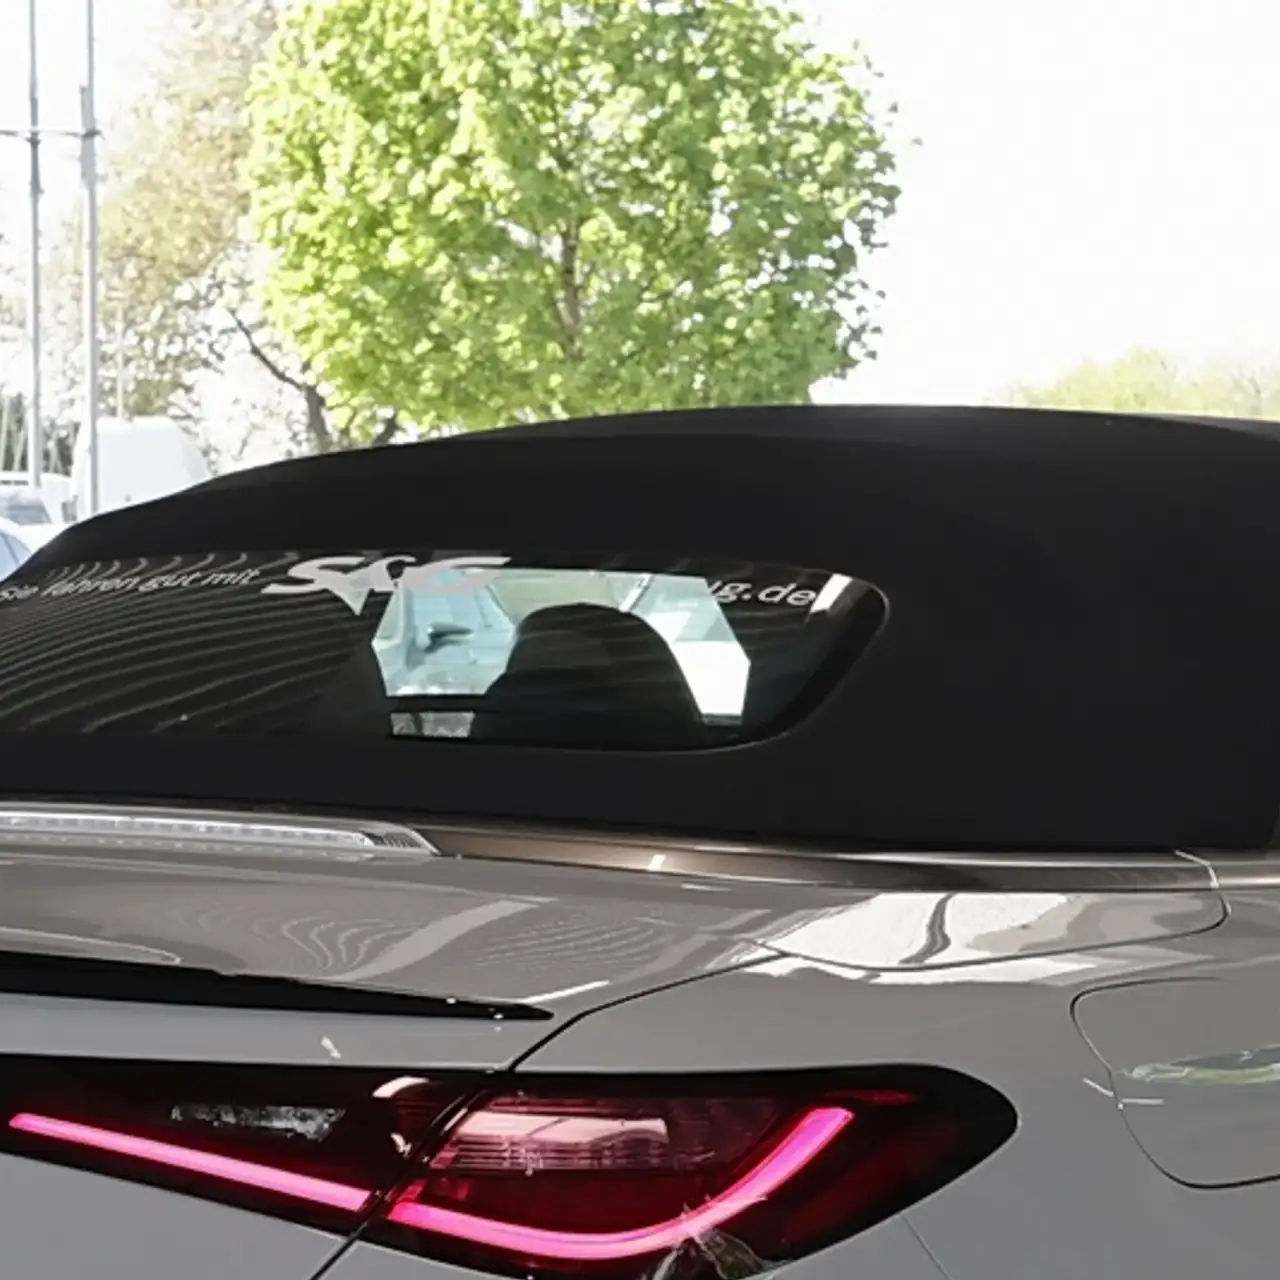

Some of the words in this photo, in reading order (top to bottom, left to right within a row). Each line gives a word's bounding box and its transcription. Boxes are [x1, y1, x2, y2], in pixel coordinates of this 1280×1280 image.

[40, 576, 140, 598] fahren
[138, 571, 202, 592] gut
[200, 567, 260, 586] mit
